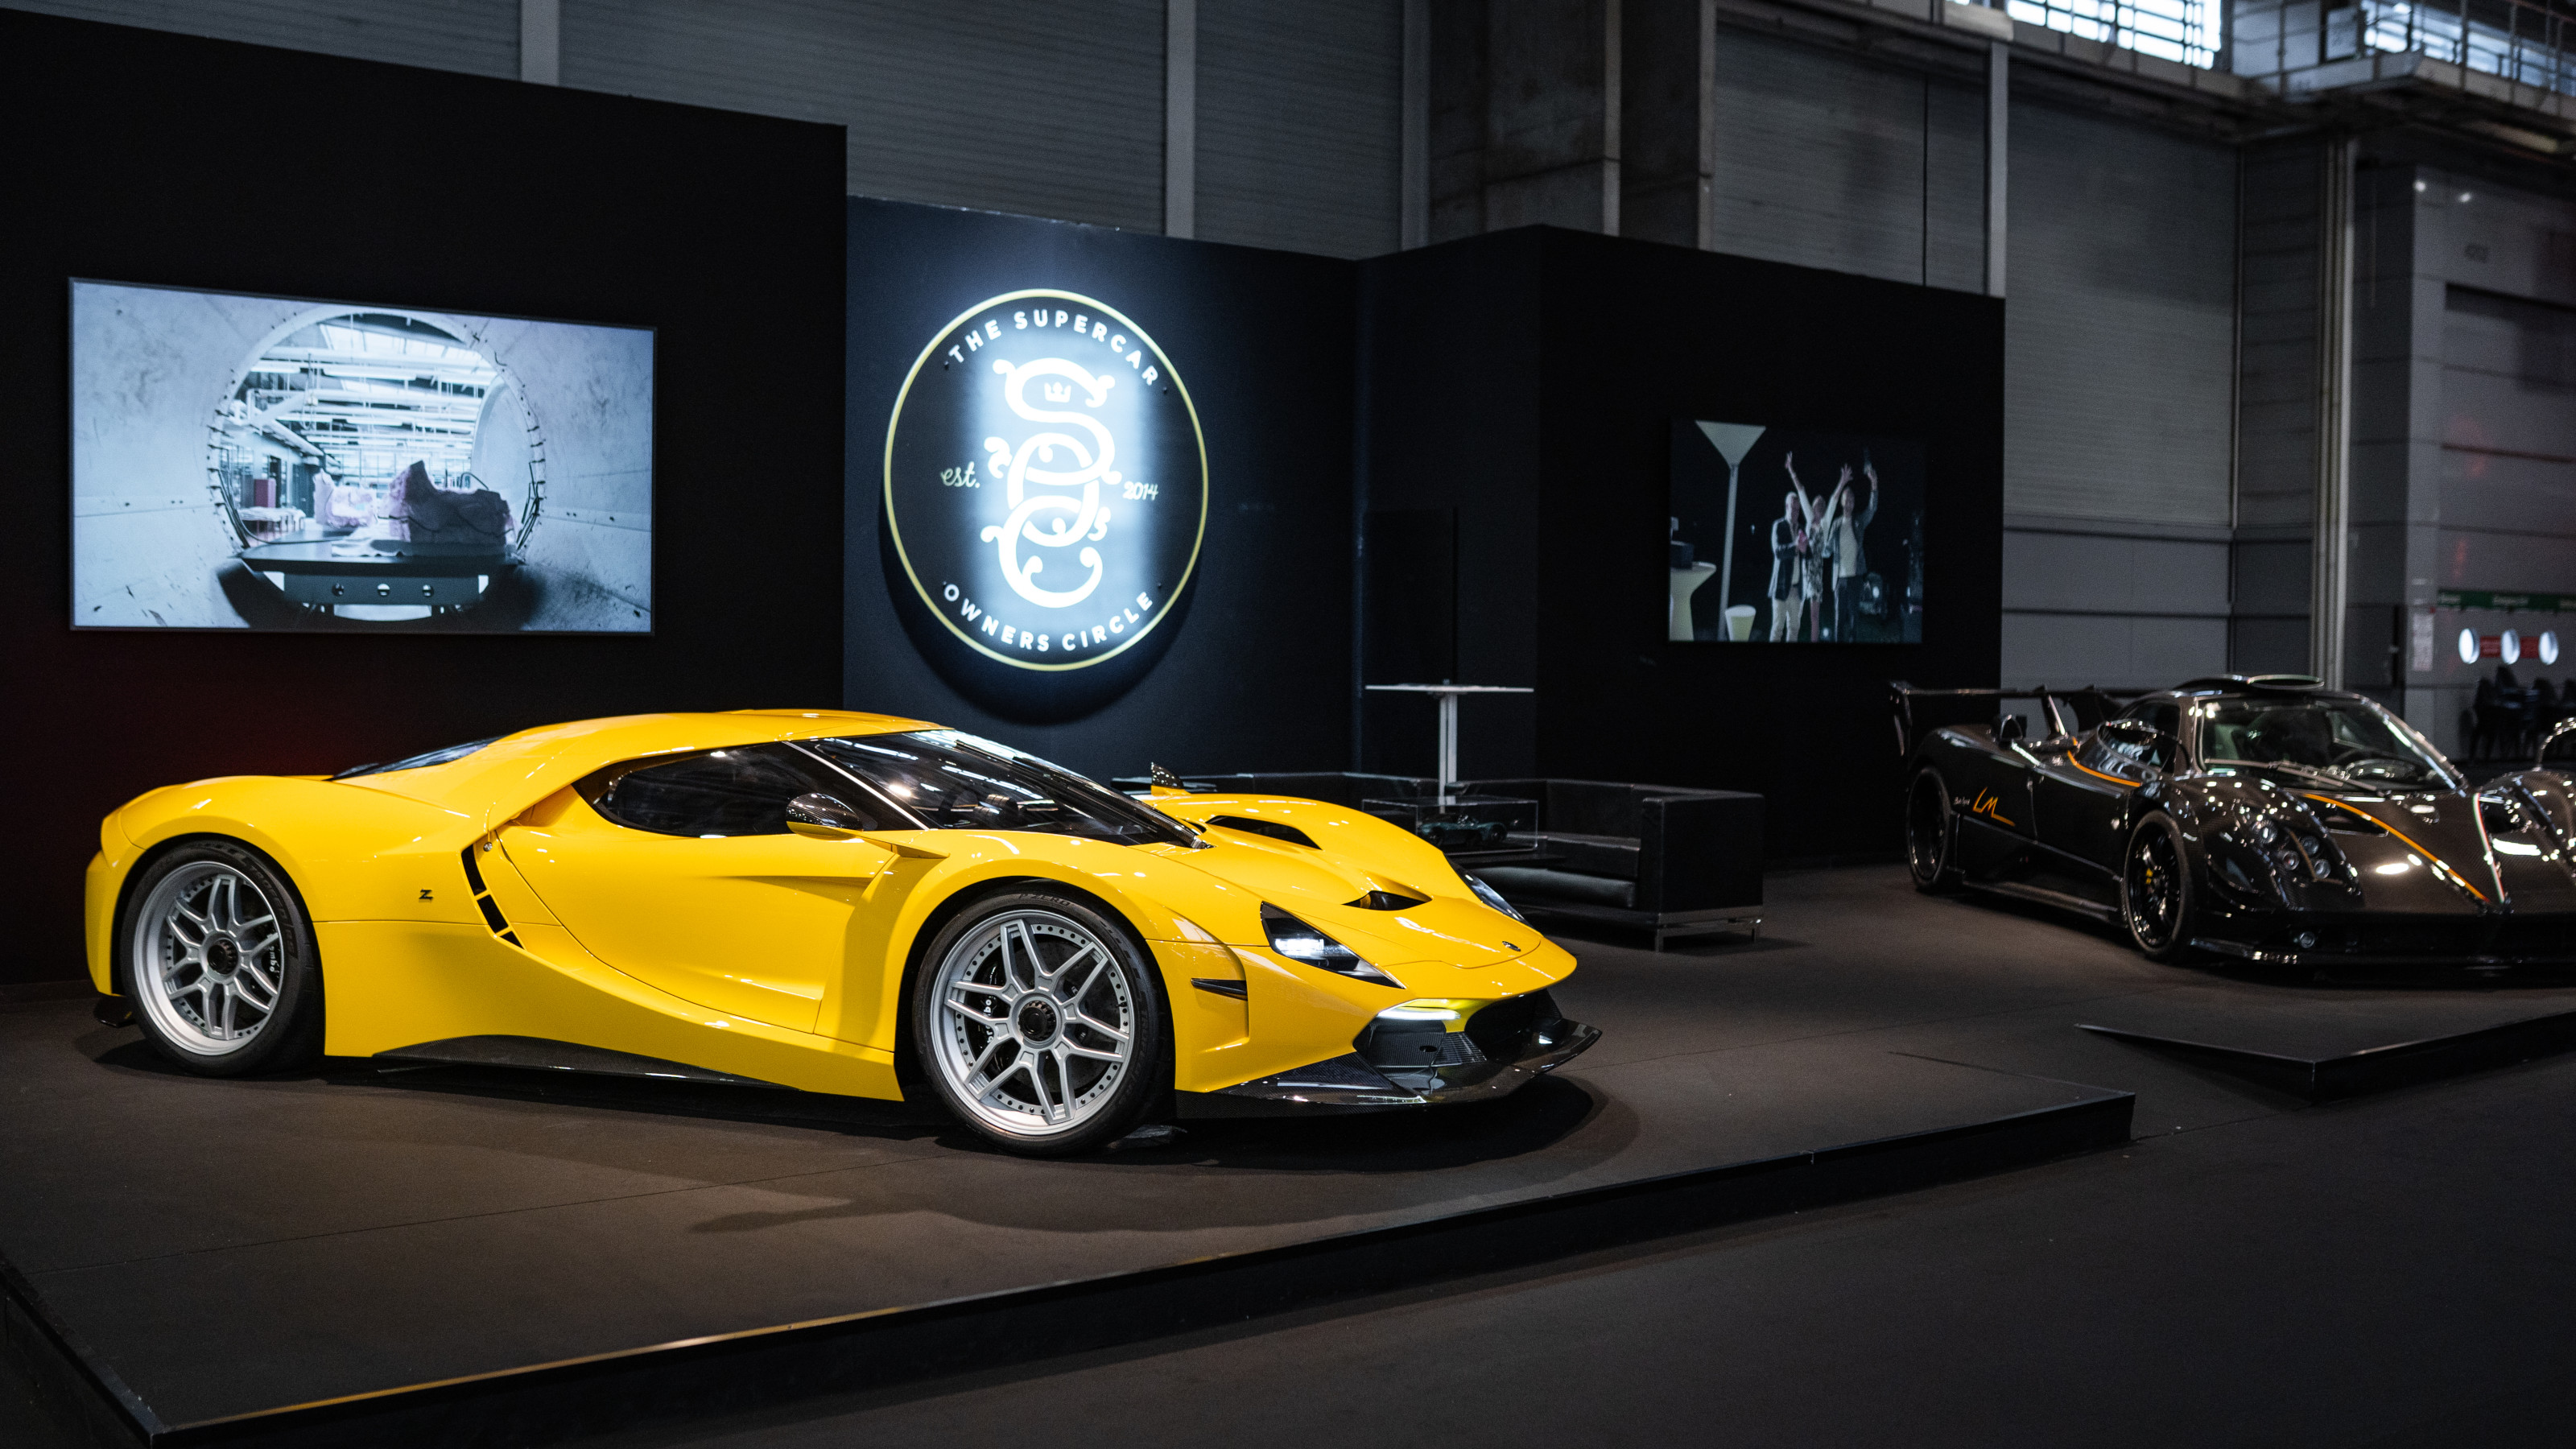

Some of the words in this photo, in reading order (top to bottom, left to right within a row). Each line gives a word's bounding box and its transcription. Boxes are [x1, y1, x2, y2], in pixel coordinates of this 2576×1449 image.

[948, 320, 1001, 364] THE
[1013, 309, 1158, 386] SUPERCAR
[940, 461, 980, 489] est.
[1122, 481, 1159, 502] 2014
[943, 584, 1049, 652] OWNERS
[1062, 592, 1153, 651] CIRCLE
[419, 889, 433, 900] Z
[1031, 894, 1071, 906] ZERO
